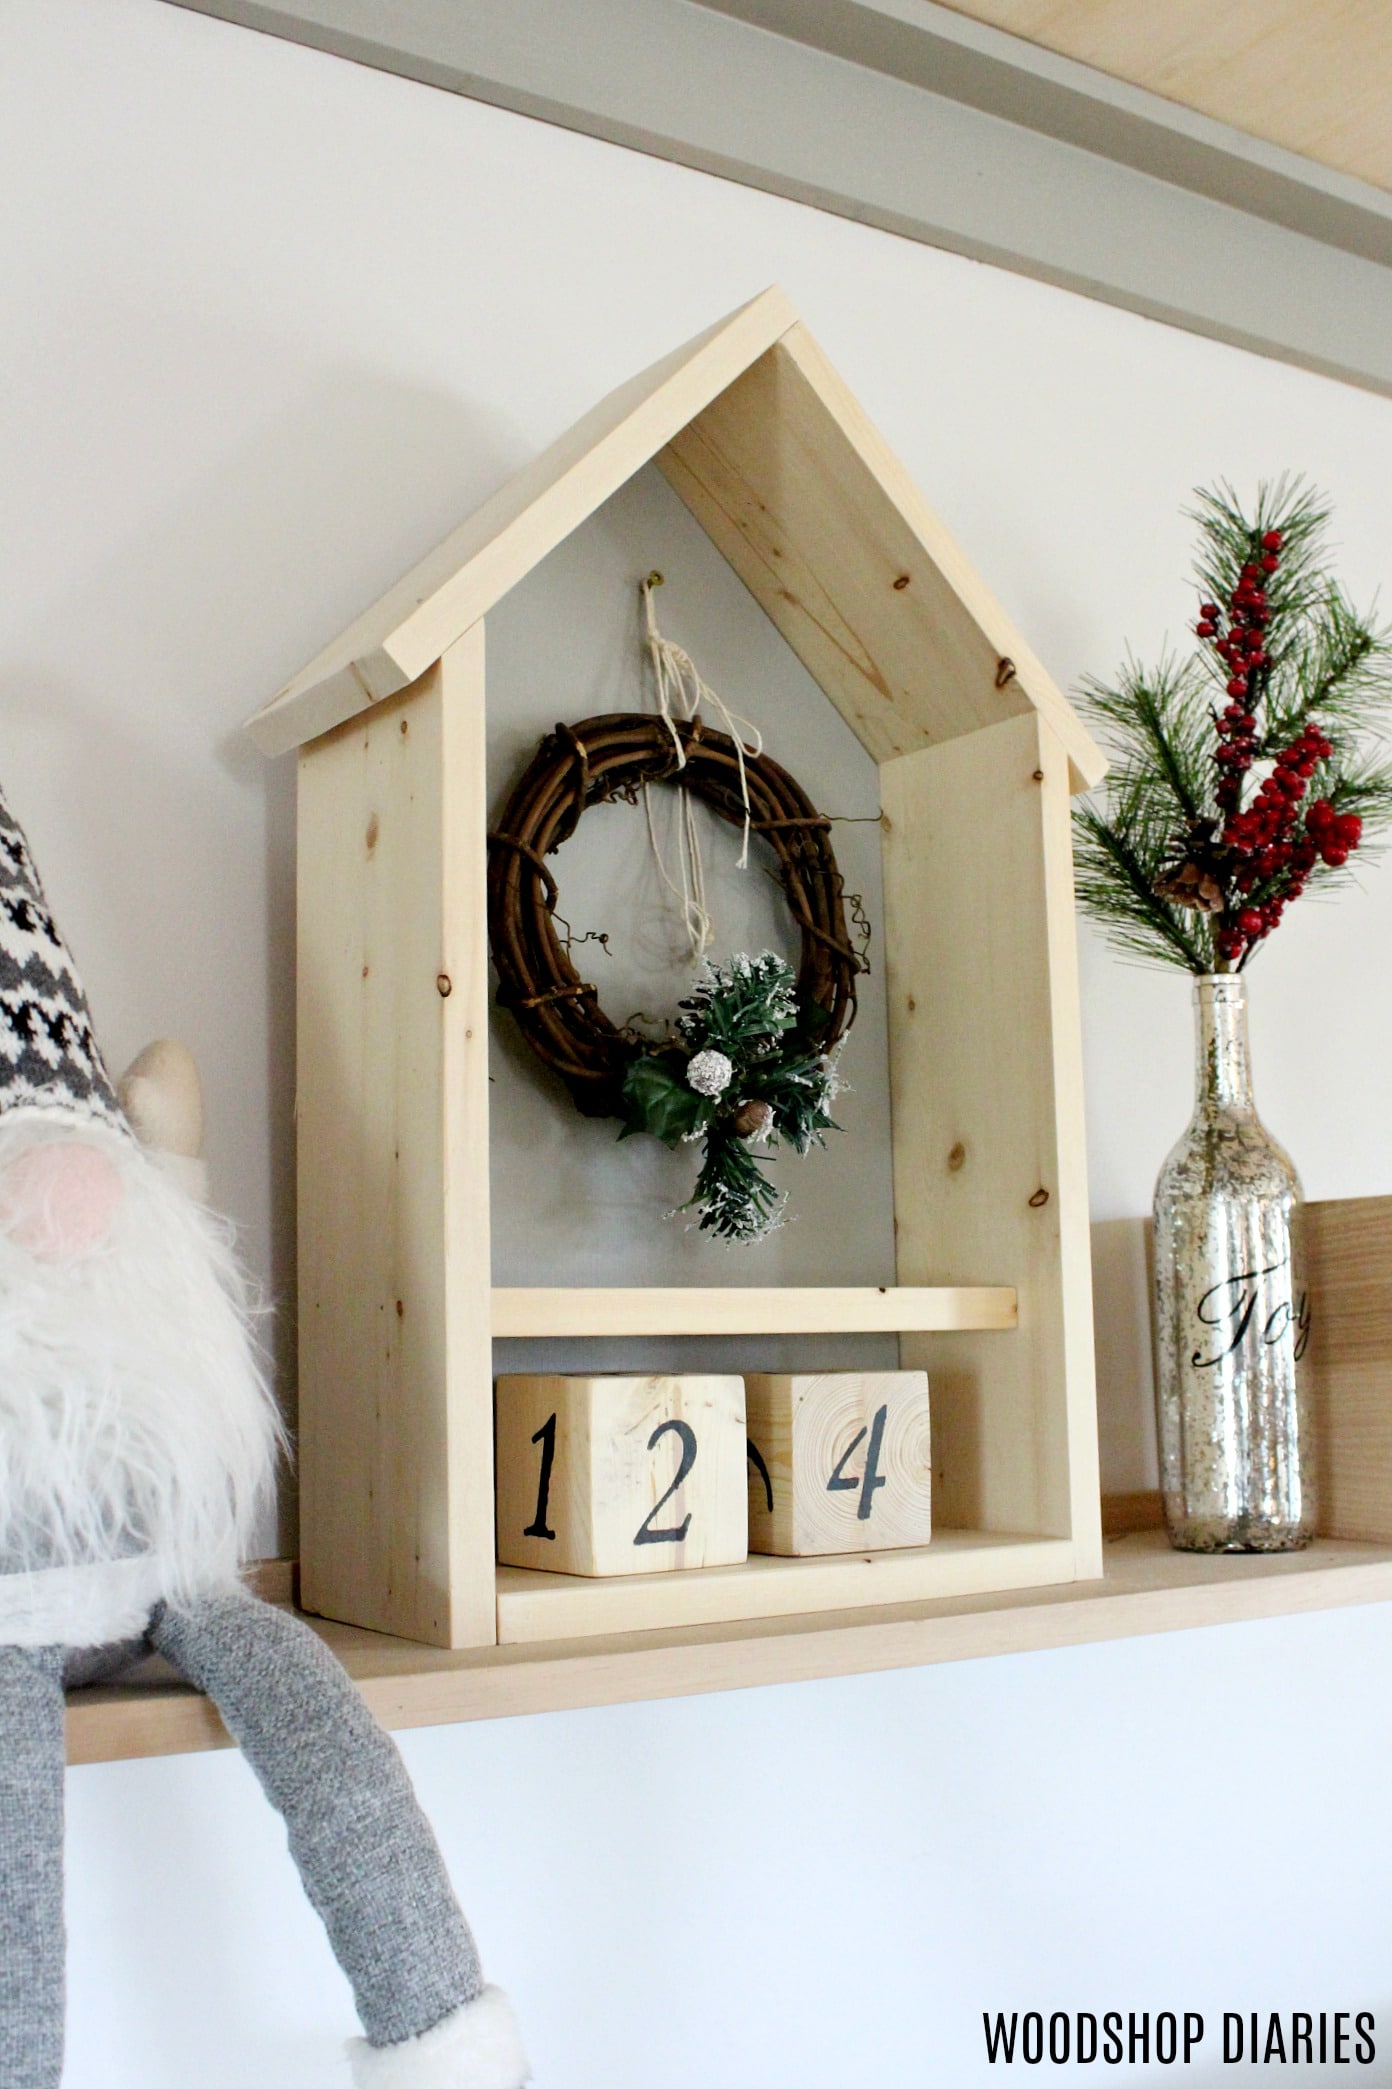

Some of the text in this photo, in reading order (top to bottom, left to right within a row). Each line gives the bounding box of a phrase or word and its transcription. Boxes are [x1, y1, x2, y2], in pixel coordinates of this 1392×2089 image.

[1192, 1257, 1311, 1368] Joy
[523, 1412, 556, 1541] 1
[633, 1419, 698, 1546] 2
[826, 1404, 887, 1520] 4
